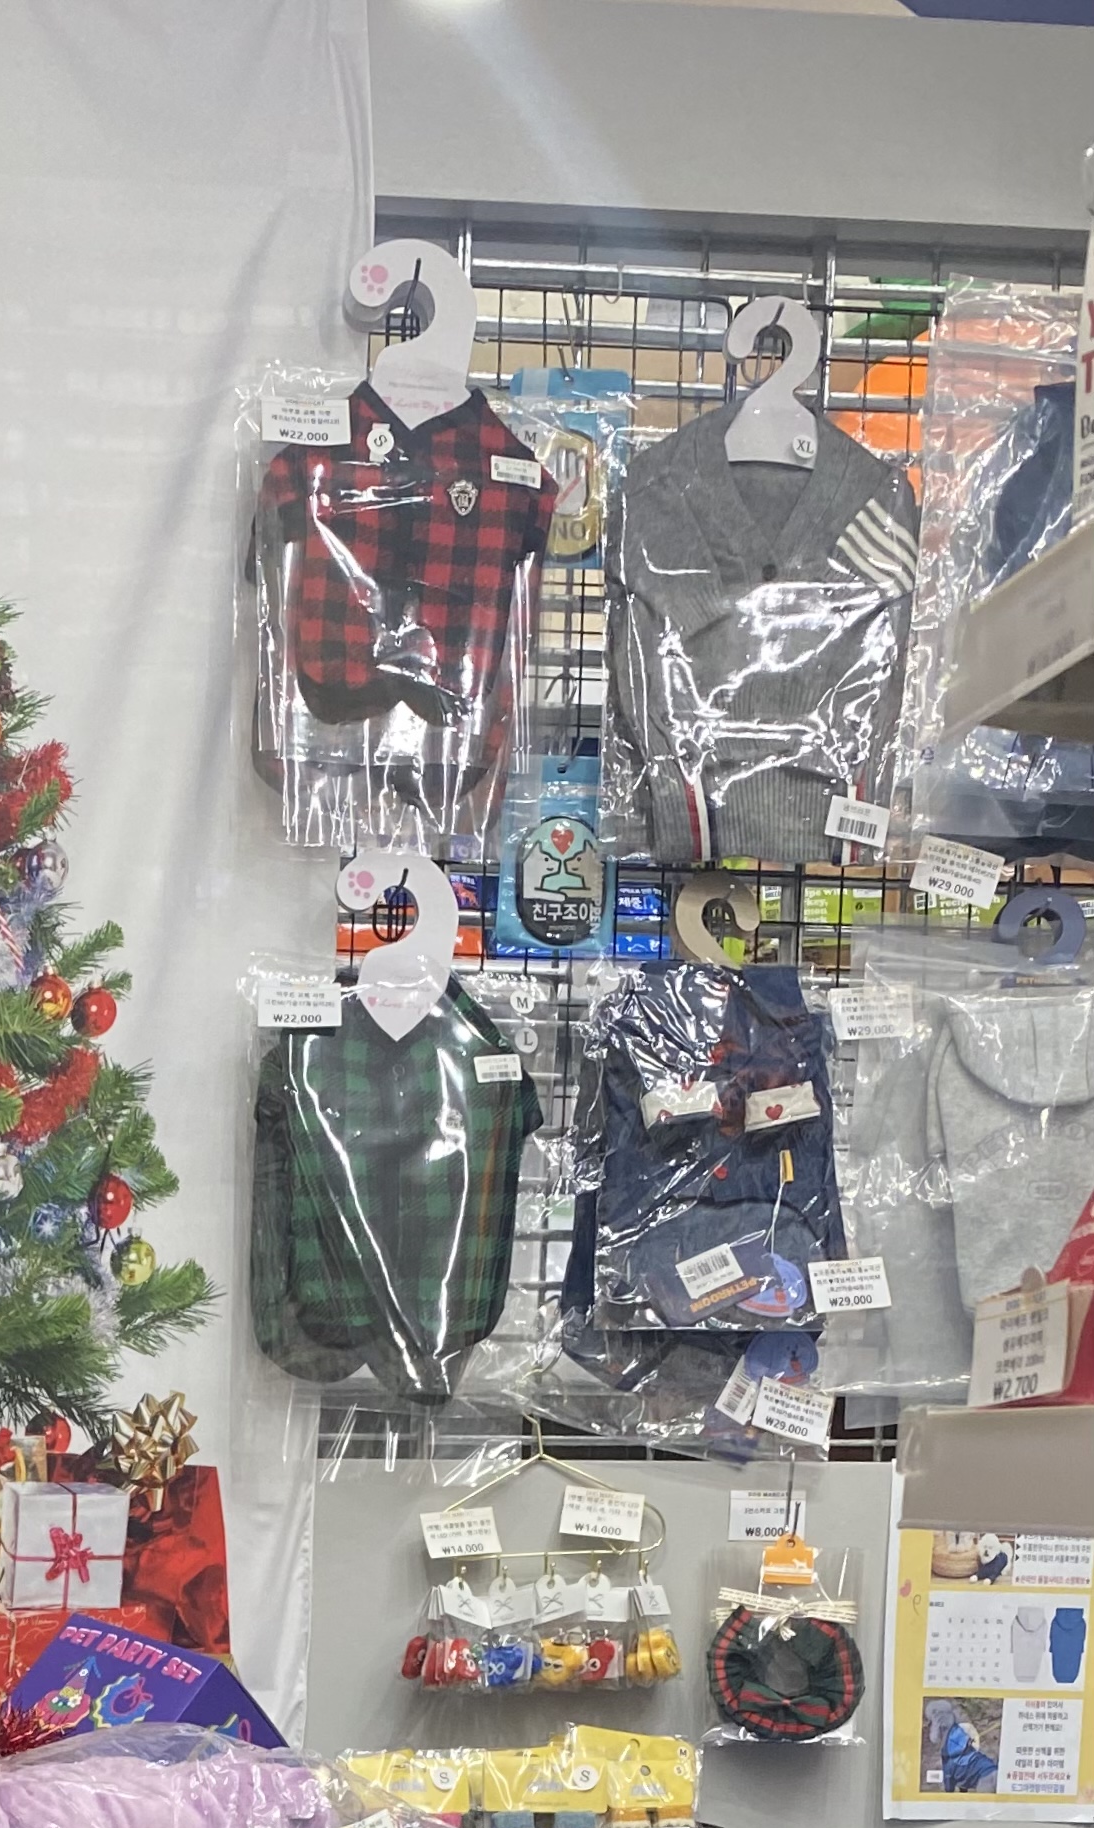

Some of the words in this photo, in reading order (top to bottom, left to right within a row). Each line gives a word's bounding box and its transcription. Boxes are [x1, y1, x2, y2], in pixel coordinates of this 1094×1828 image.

[279, 429, 329, 441] ₩22,000
[374, 434, 387, 447] S
[524, 431, 538, 444] M
[796, 438, 815, 455] XL
[552, 519, 587, 541] NO
[928, 877, 975, 899] ₩29,000
[516, 996, 529, 1009] M
[273, 1013, 322, 1024] ₩22,000
[523, 1032, 534, 1046] L
[828, 1295, 873, 1308] ₩29,000
[765, 1416, 809, 1437] ₩29,000
[574, 1523, 622, 1536] ₩14,000
[745, 1527, 784, 1538] ₩8,000
[441, 1543, 485, 1555] ₩14,000
[59, 1625, 103, 1648] PET
[95, 1632, 168, 1670] PARTY
[160, 1656, 203, 1685] SET
[439, 1772, 450, 1784] S
[579, 1769, 591, 1783] S
